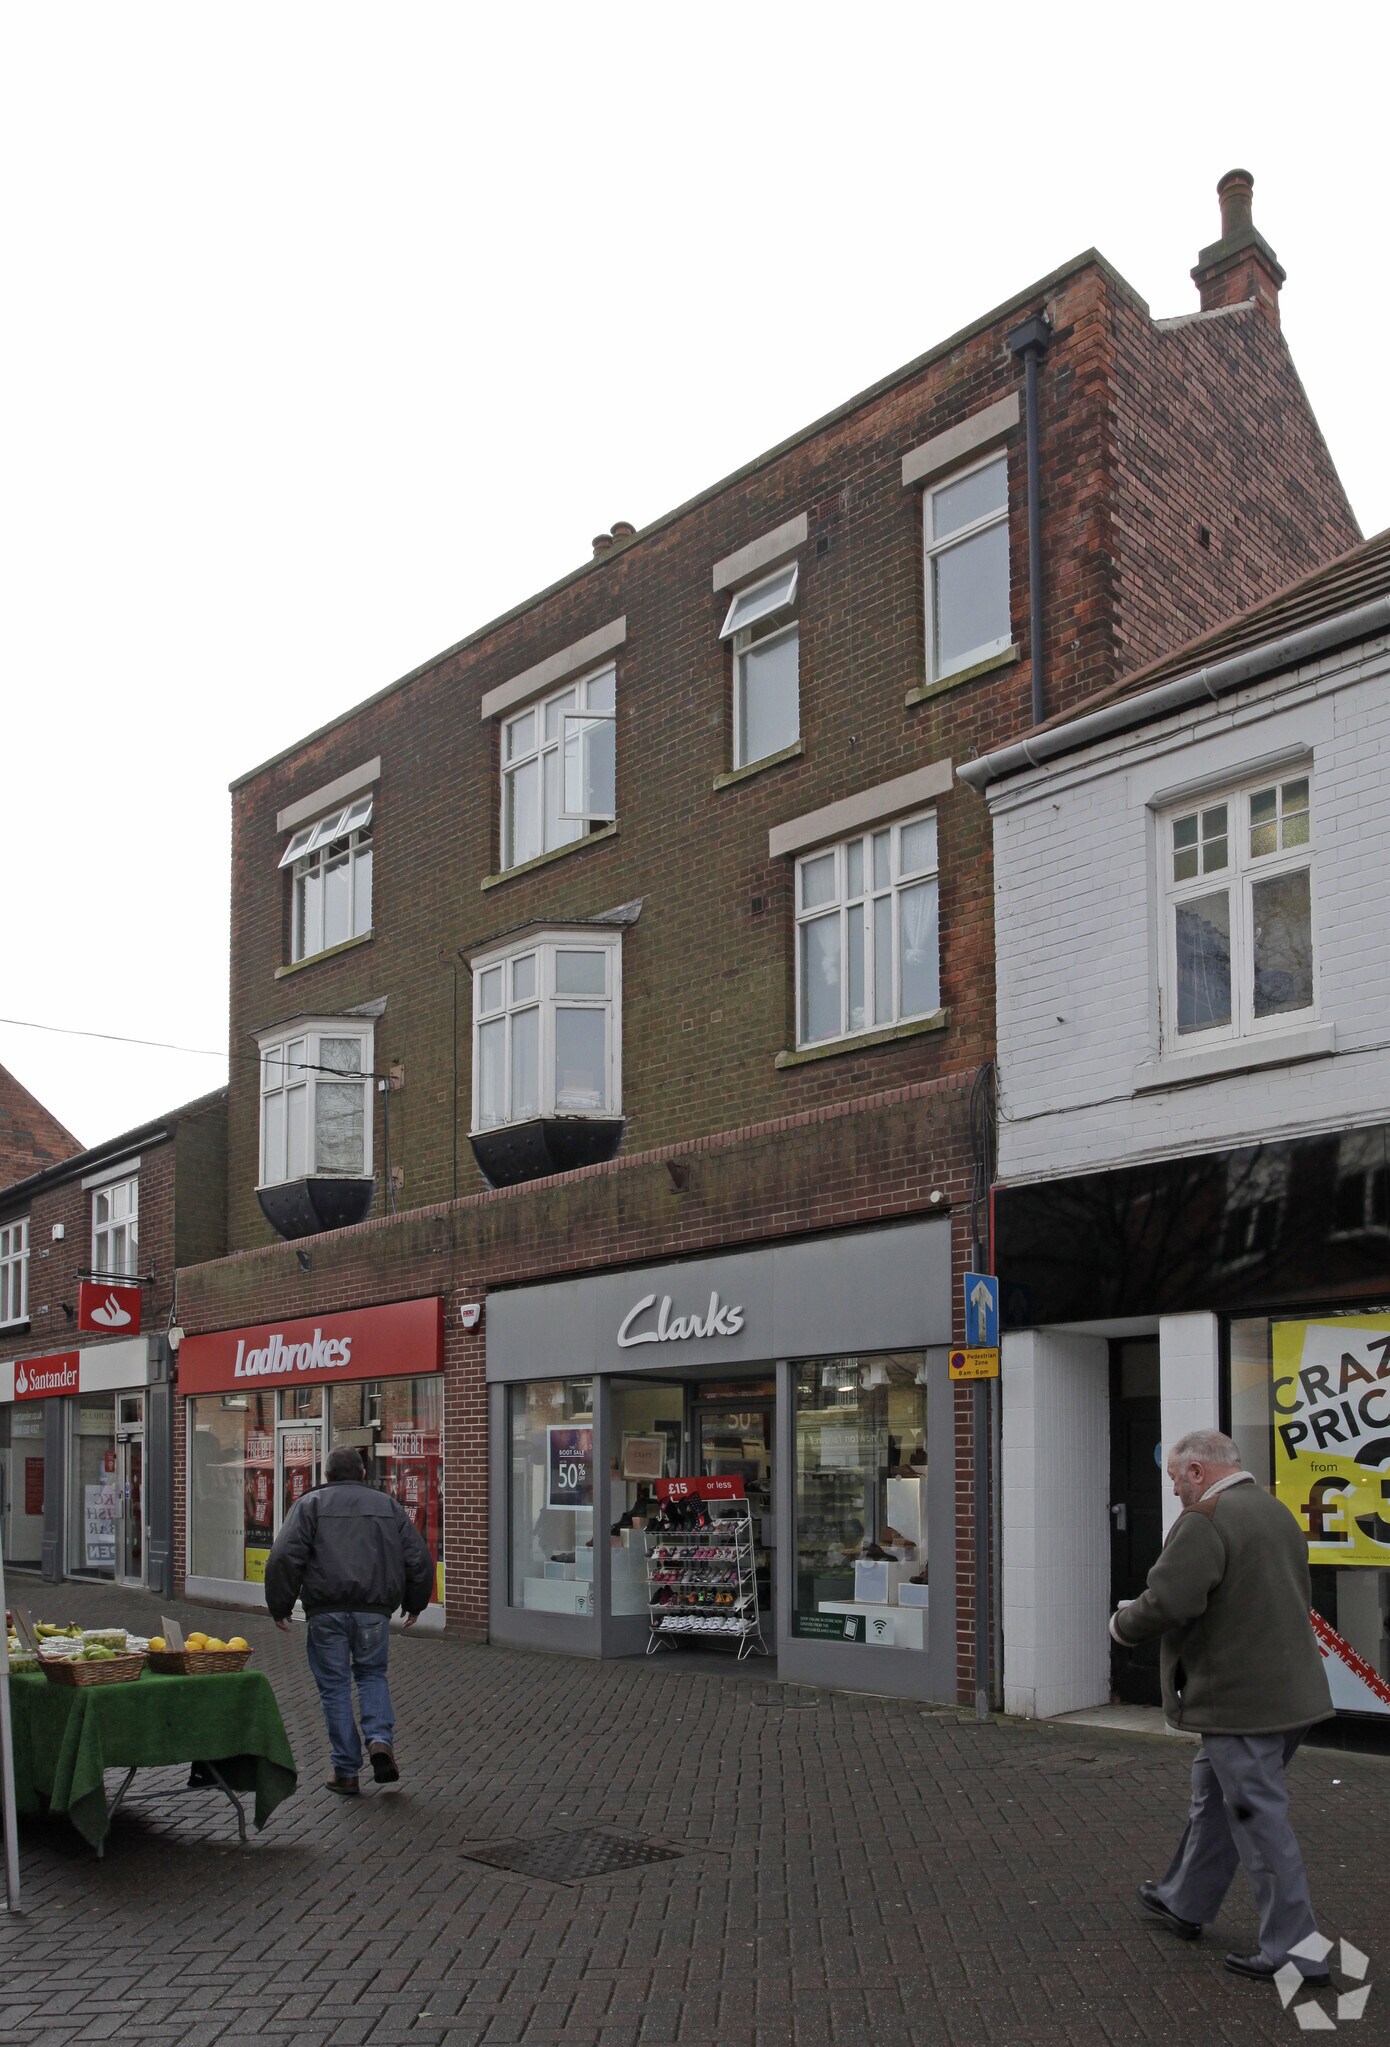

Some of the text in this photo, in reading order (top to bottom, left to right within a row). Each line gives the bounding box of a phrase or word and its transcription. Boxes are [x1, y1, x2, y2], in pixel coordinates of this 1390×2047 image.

[617, 1291, 744, 1348] Clarks
[29, 1361, 77, 1391] Santander
[234, 1328, 352, 1377] Ladbrokes
[1271, 1336, 1390, 1414] CRAZ
[392, 1433, 408, 1455] FREE
[411, 1433, 424, 1454] BET
[1278, 1388, 1390, 1461] PRIC
[668, 1483, 688, 1494] £15
[716, 1480, 732, 1489] less
[1310, 1461, 1338, 1472] from
[1309, 1620, 1328, 1642] ALE
[1330, 1644, 1353, 1667] SALE
[1355, 1669, 1379, 1693] SALE
[1323, 1621, 1346, 1645] SALE
[1347, 1645, 1371, 1671] SALE
[1373, 1672, 1390, 1694] SAL
